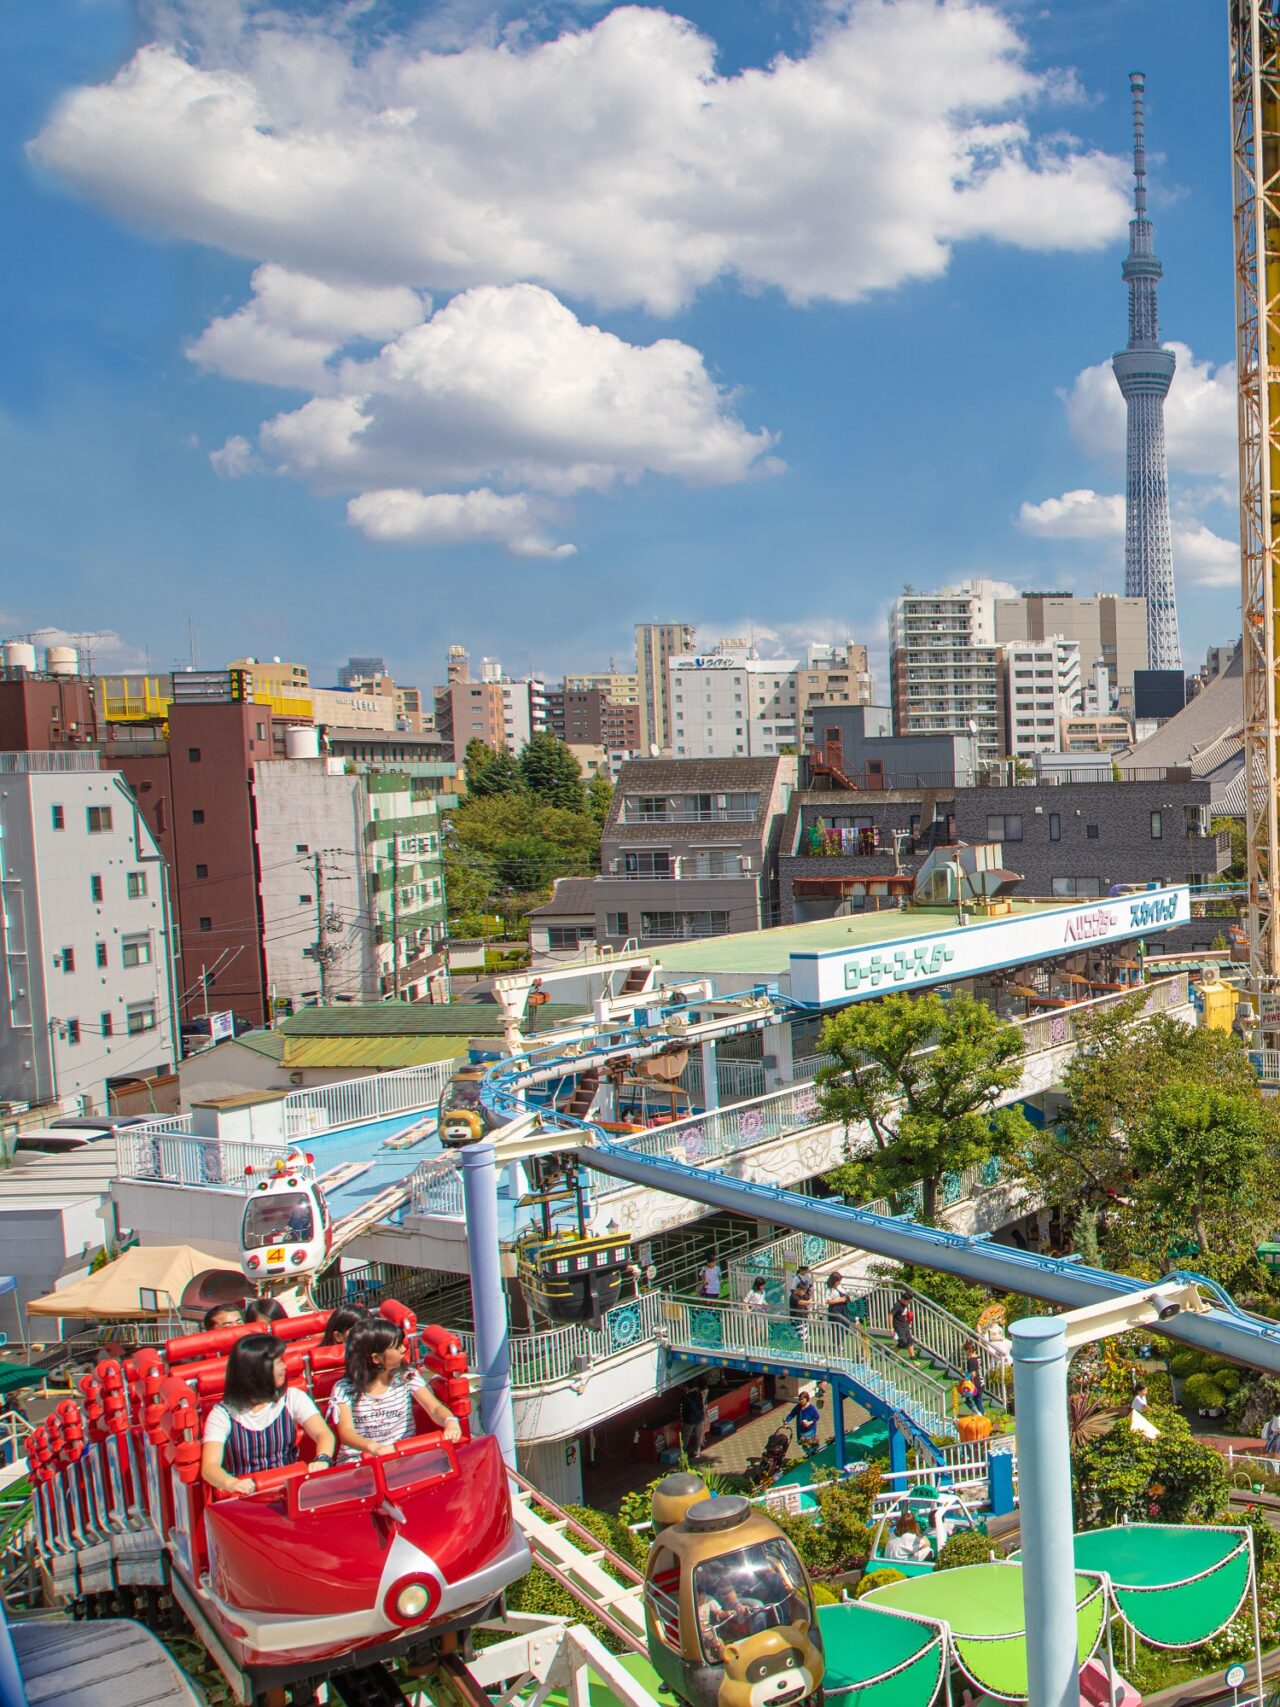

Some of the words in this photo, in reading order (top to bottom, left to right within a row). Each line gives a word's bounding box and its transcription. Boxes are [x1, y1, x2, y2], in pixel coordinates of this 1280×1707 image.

[1063, 909, 1119, 943] ヘリコプター
[844, 943, 955, 990] ローラーコースター
[268, 1249, 284, 1262] 4
[911, 1489, 933, 1498] TAXI
